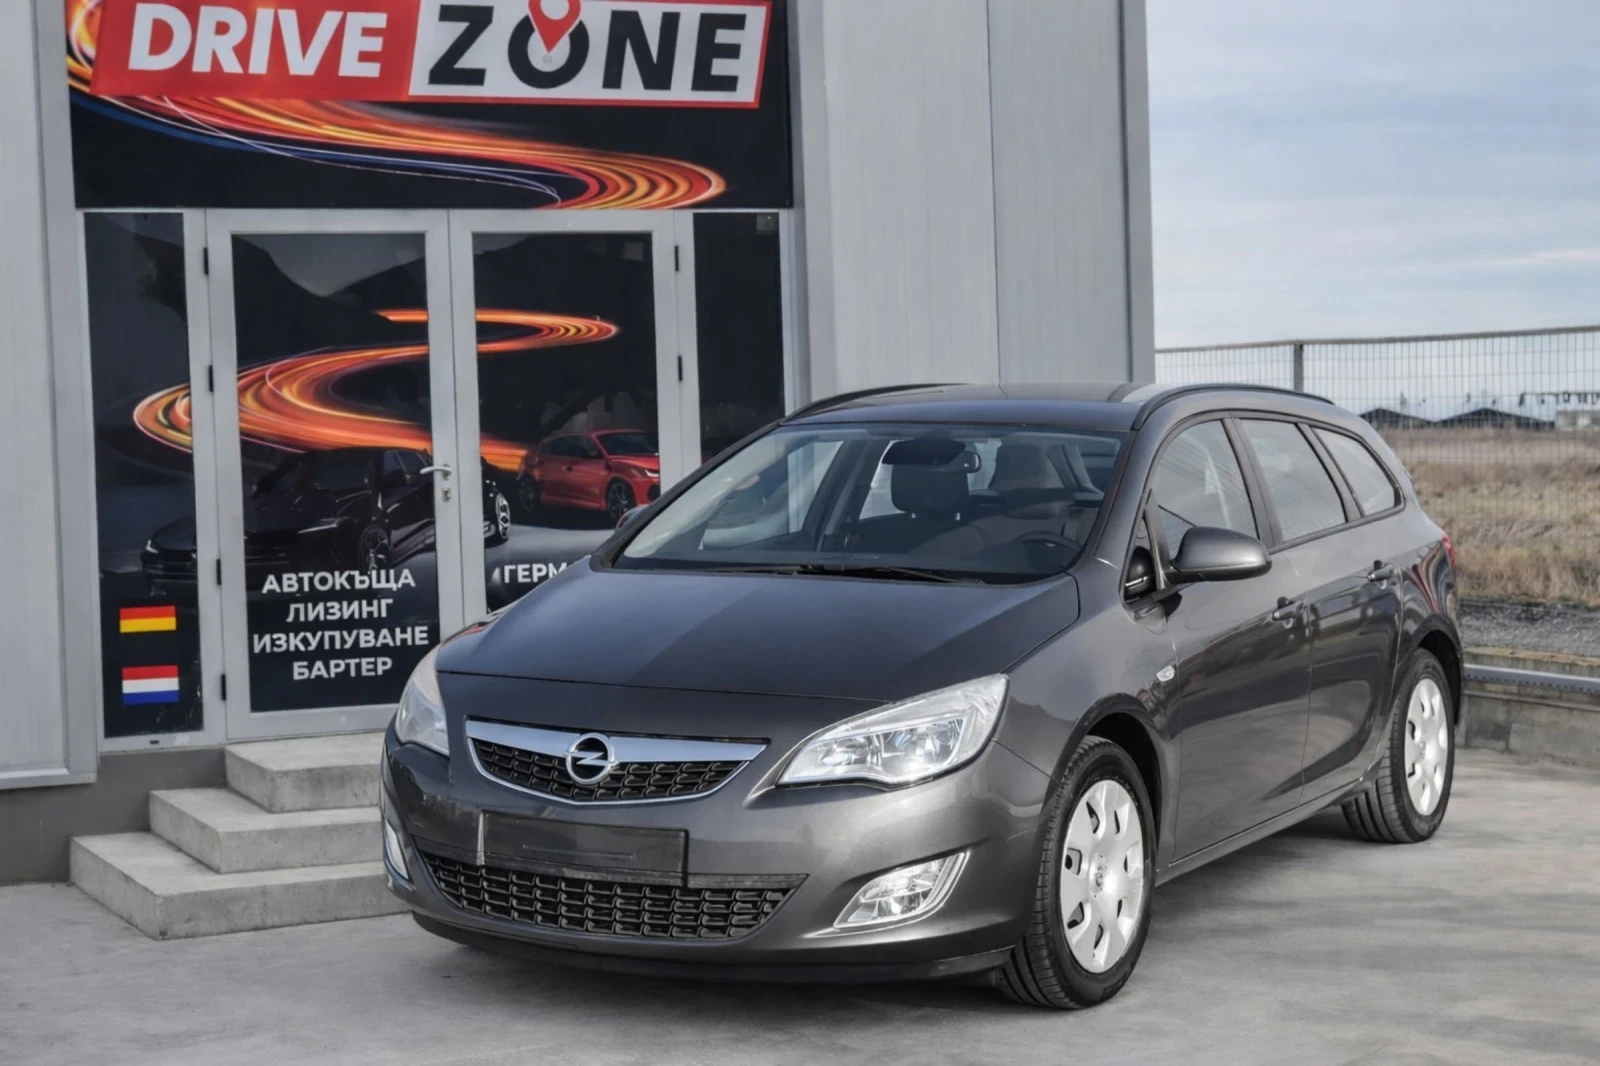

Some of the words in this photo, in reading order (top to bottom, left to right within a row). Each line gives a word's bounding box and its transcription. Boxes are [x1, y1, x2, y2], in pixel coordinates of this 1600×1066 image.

[128, 2, 387, 78] DRIVE
[428, 3, 747, 92] ZONE
[261, 569, 416, 593] АВТОКЪЩА
[286, 598, 393, 622] ЛИЗИНГ
[252, 626, 429, 653] ИЗКУПУВАНЕ
[292, 657, 393, 681] БАРТЕР
